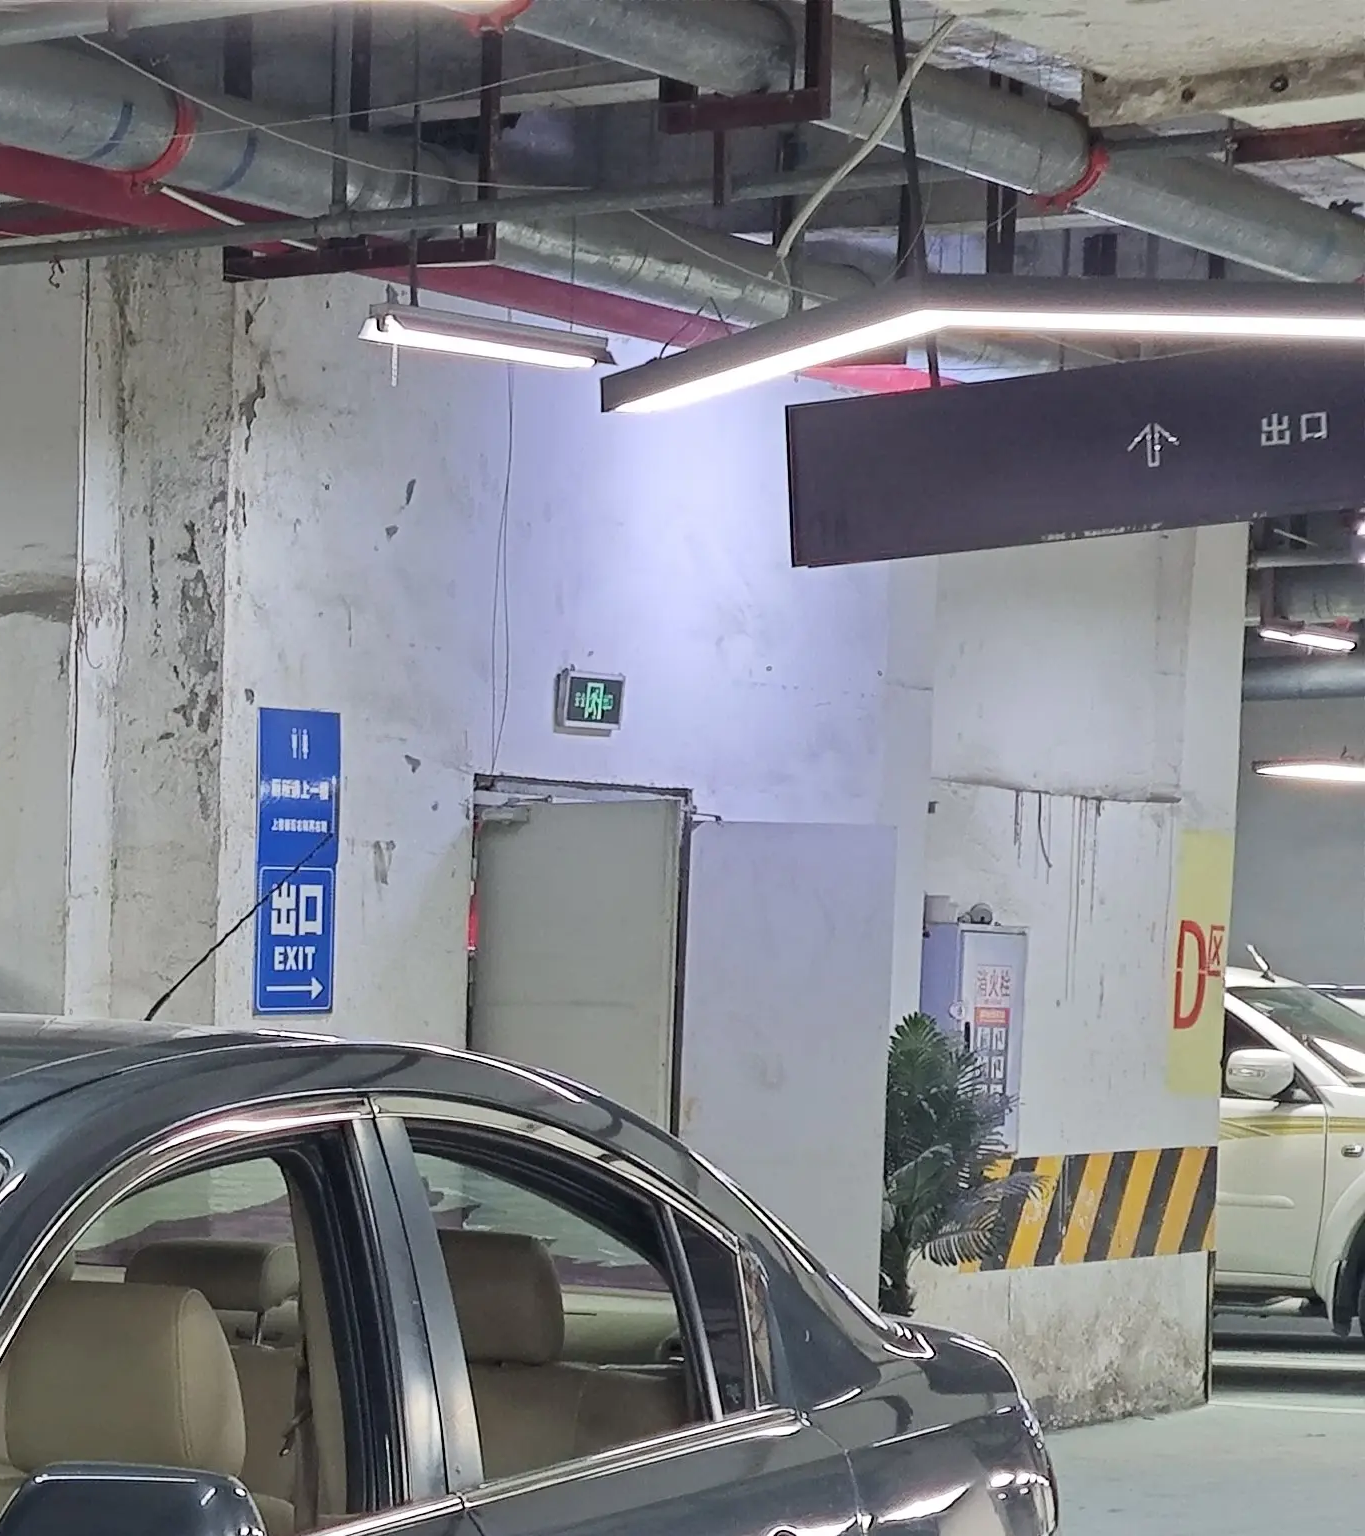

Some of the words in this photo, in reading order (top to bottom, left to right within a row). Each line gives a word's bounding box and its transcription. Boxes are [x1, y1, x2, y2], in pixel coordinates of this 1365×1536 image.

[1261, 411, 1328, 446] 出口
[270, 881, 324, 937] 出口
[273, 945, 317, 972] EXIT
